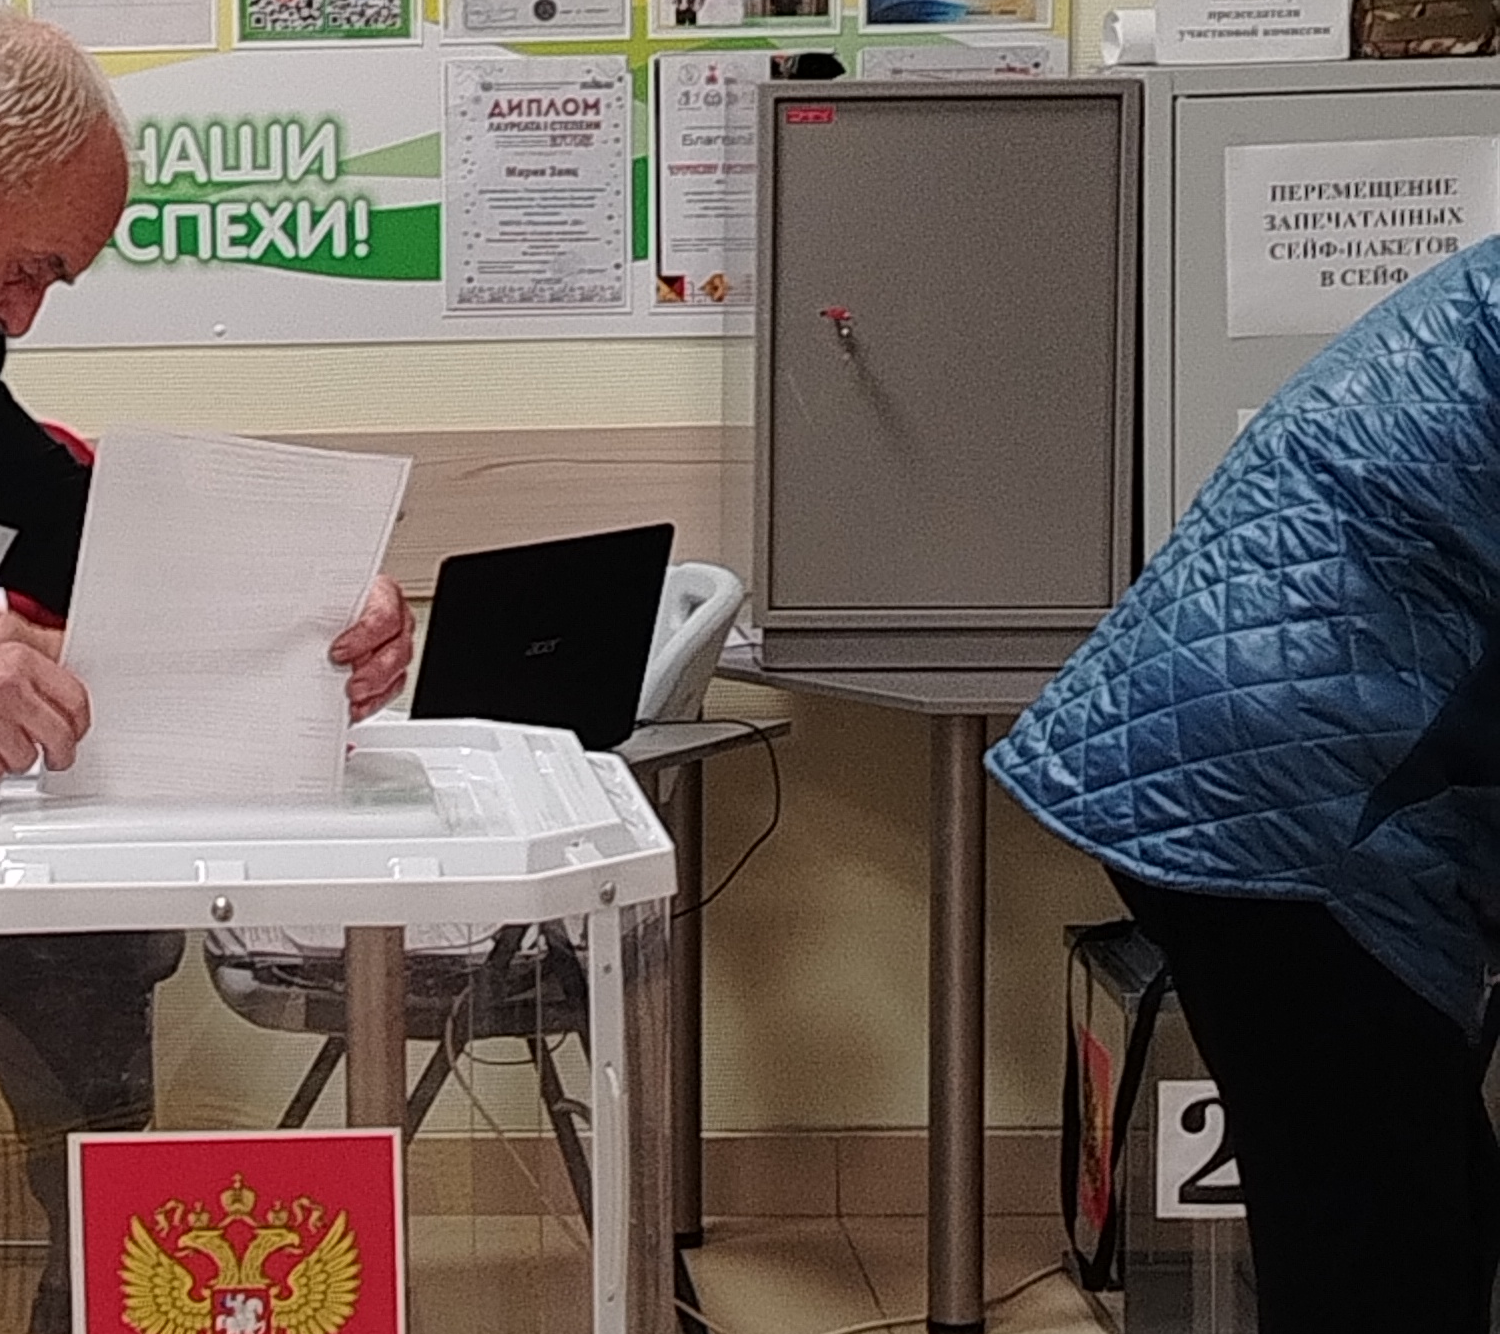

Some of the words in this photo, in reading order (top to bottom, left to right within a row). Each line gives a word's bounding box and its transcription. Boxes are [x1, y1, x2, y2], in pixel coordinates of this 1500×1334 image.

[1207, 8, 1301, 23] председателя
[1178, 26, 1259, 42] участковой
[1262, 26, 1331, 37] комиссии
[487, 97, 602, 119] ДИПЛОМ
[133, 122, 338, 185] НАШИ
[1269, 177, 1459, 203] ПЕРЕМЕЩЕНИЕ
[113, 199, 371, 263] СПЕХИ!
[1262, 206, 1465, 232] ЗАПЕЧАТАННЫХ
[1268, 236, 1460, 260] СЕЙФ-ПАКЕТОВ
[1320, 270, 1335, 288] В
[1340, 265, 1410, 288] СЕЙФ
[1179, 1097, 1247, 1205] 2
